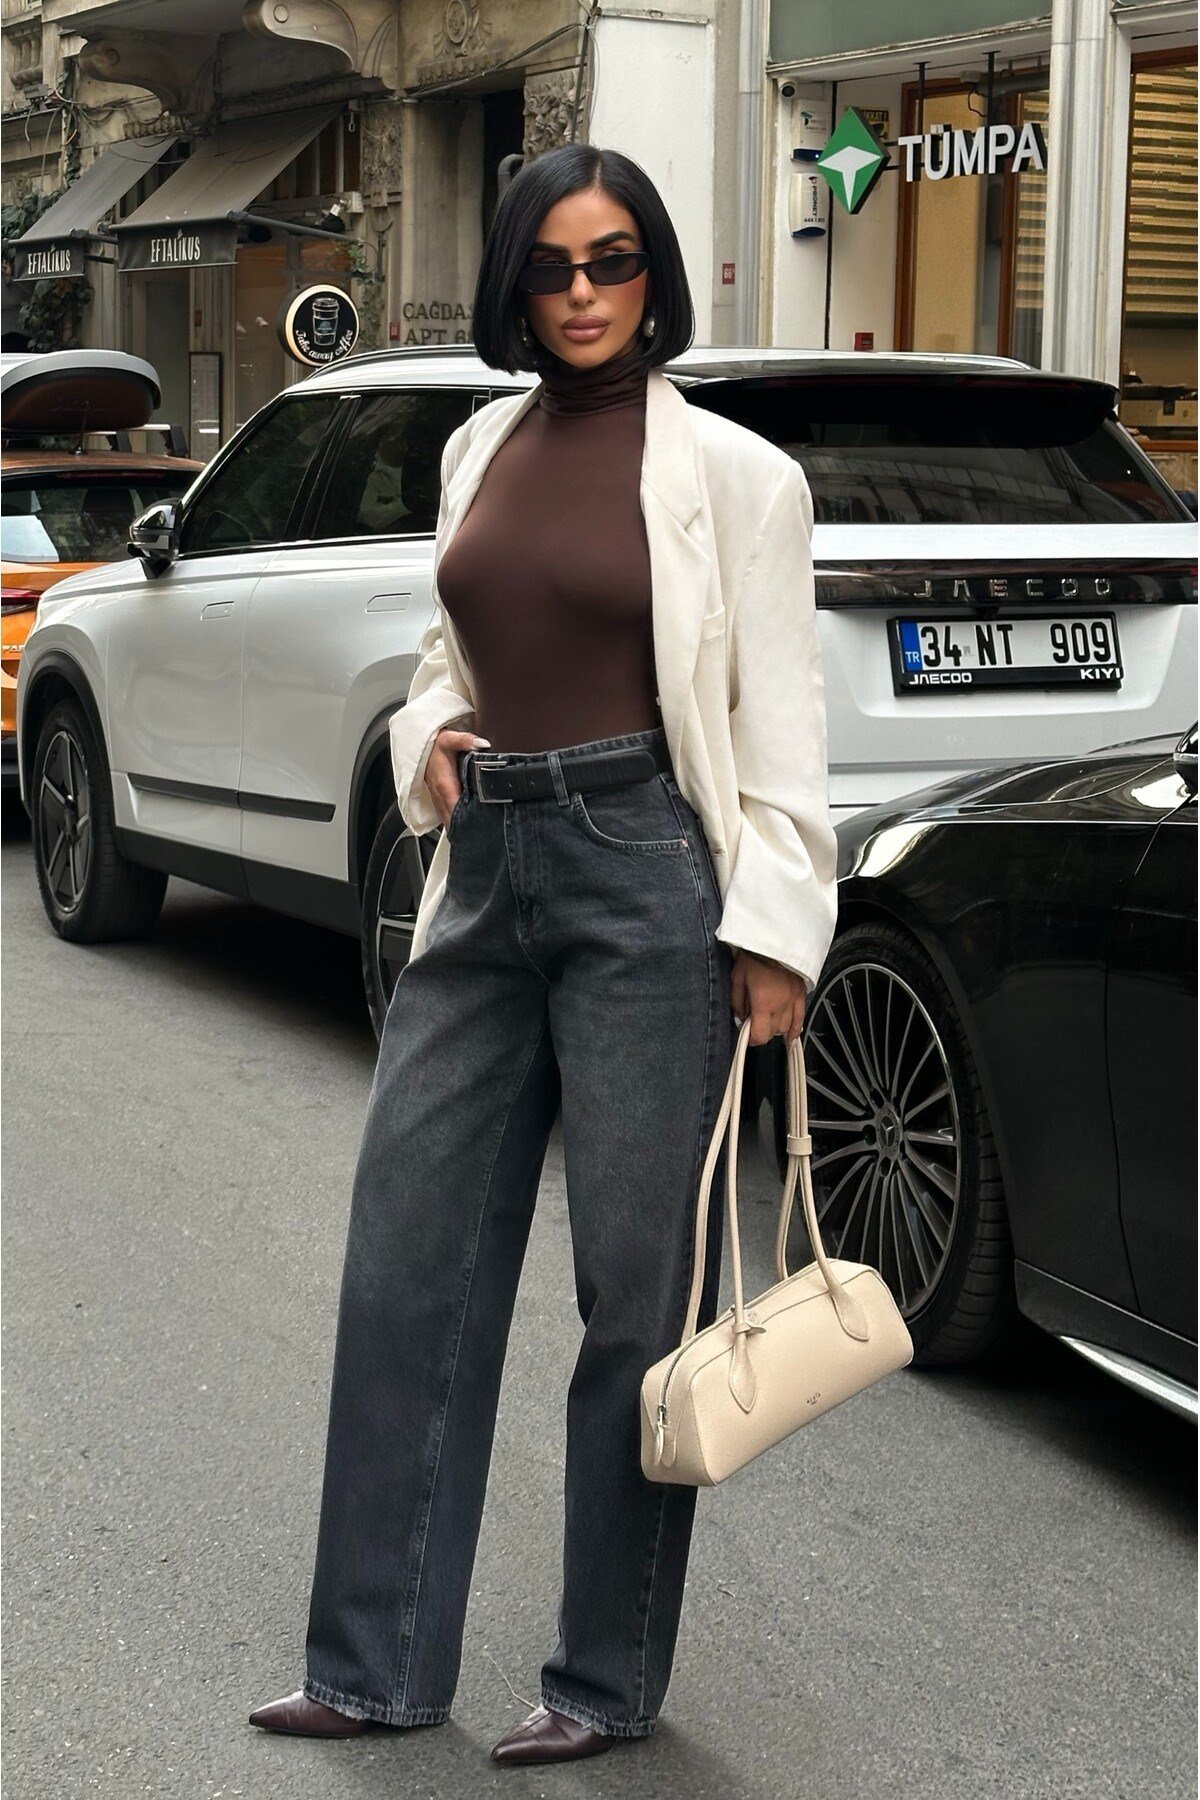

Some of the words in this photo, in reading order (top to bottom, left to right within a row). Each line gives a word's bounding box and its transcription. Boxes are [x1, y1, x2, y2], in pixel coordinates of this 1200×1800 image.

[898, 122, 1044, 182] TÜMPA
[913, 578, 1111, 598] JAECOO
[920, 625, 962, 667] 34
[975, 624, 1013, 666] NT
[1050, 621, 1112, 664] 909
[906, 651, 920, 663] TR
[909, 672, 973, 685] JAECOO
[1080, 667, 1122, 680] KIYI
